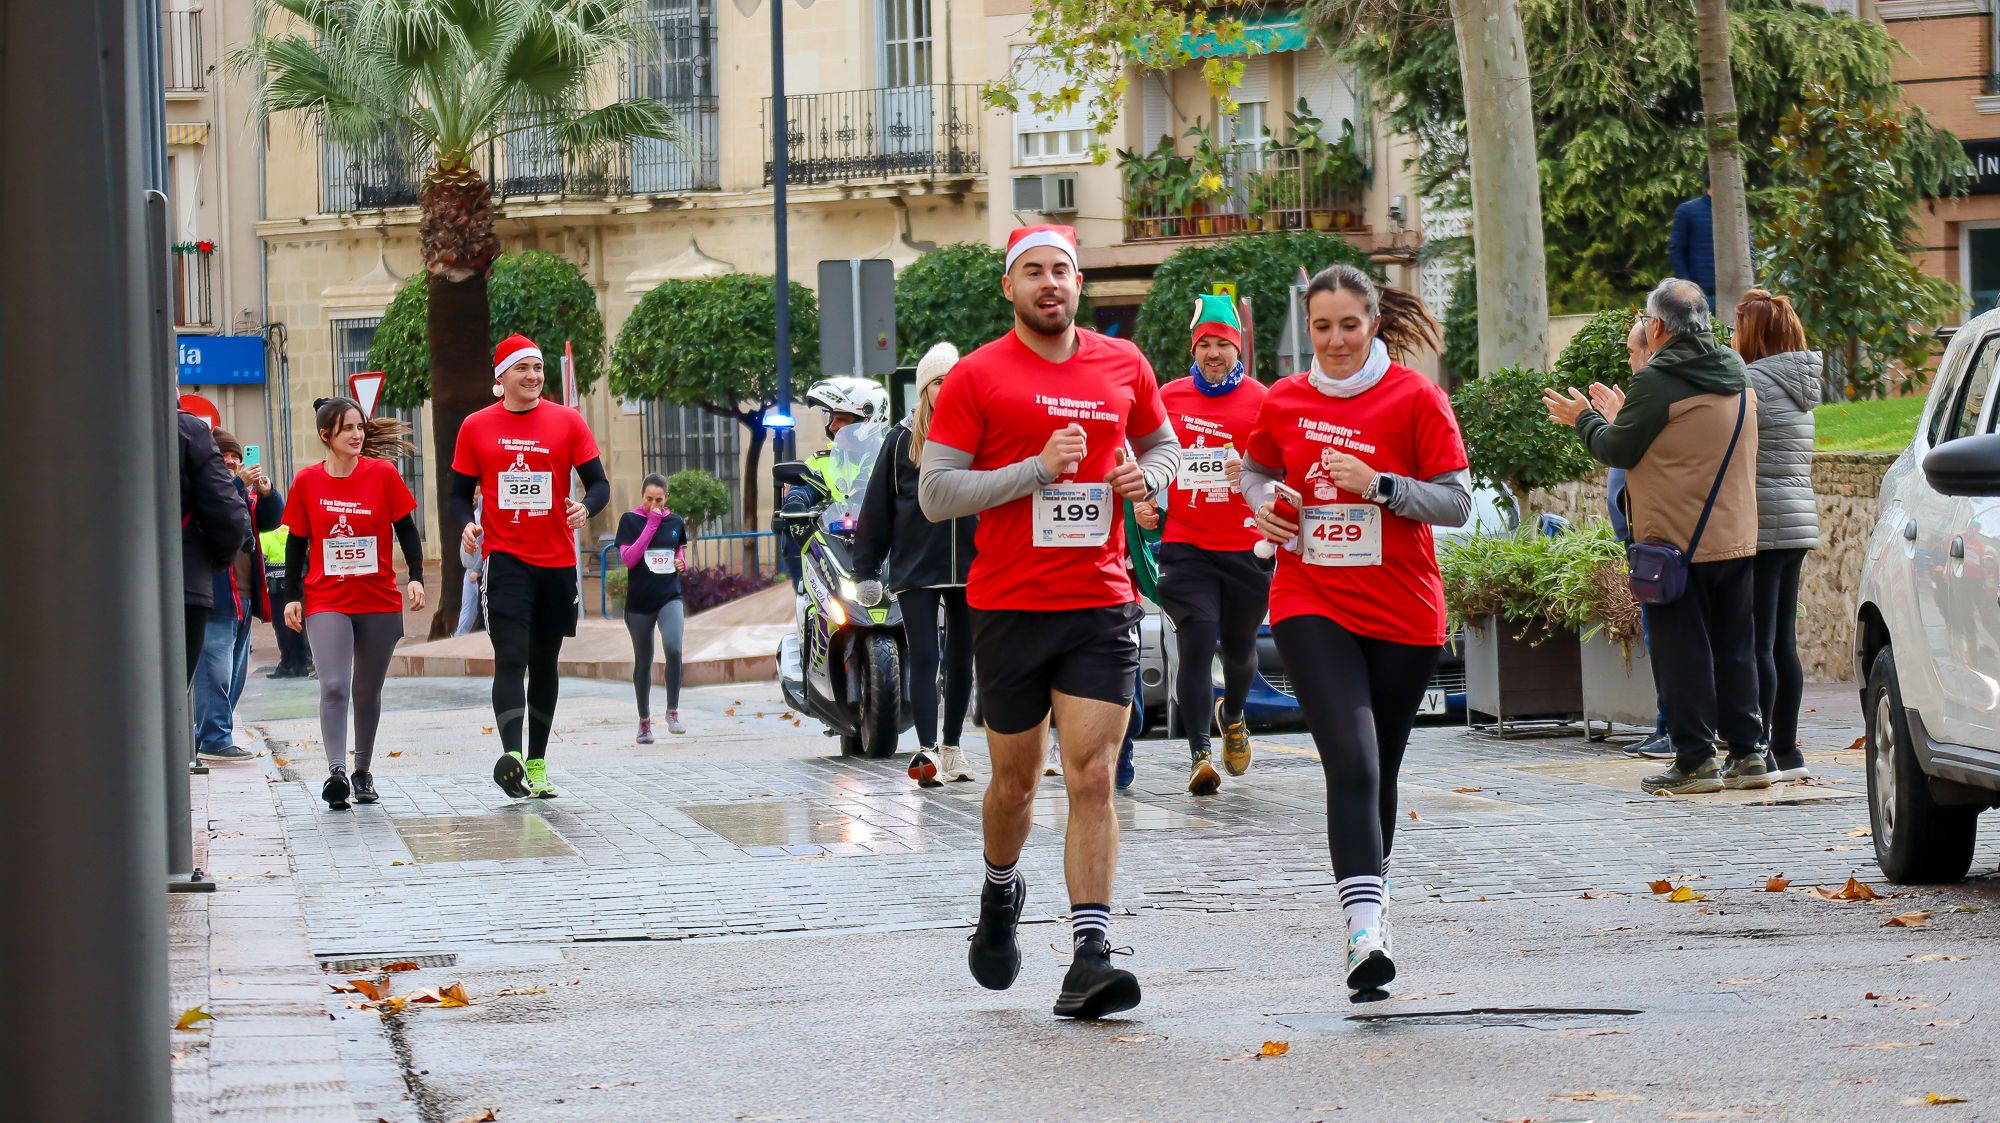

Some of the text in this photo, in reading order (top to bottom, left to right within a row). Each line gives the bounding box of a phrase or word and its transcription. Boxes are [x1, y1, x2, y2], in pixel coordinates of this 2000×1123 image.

[1042, 395, 1058, 406] San
[1048, 406, 1119, 422] Ciudad de Lucena
[1303, 419, 1317, 430] San
[1305, 430, 1376, 454] Ciudad de Lucena
[1188, 461, 1223, 472] 468
[510, 484, 541, 494] 328
[1053, 504, 1099, 521] 199
[1312, 524, 1361, 541] 429
[336, 548, 366, 560] 155
